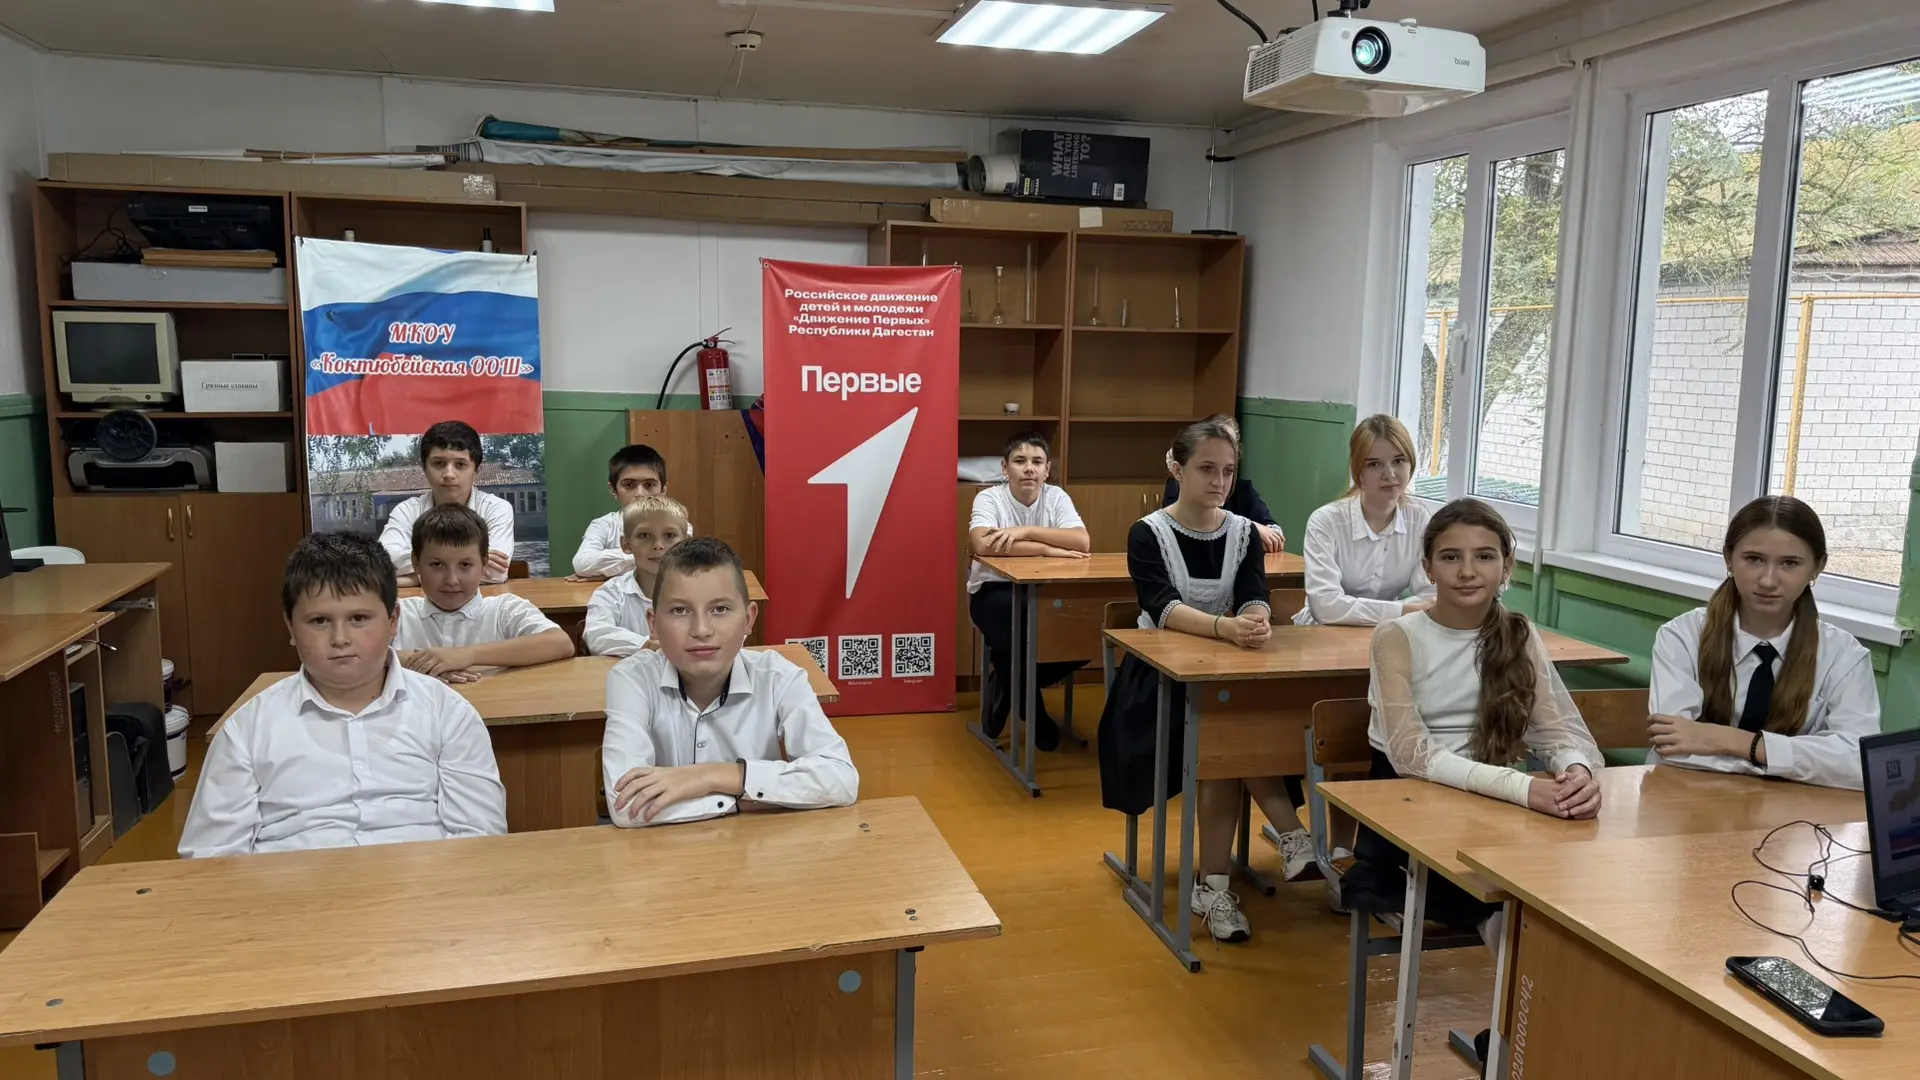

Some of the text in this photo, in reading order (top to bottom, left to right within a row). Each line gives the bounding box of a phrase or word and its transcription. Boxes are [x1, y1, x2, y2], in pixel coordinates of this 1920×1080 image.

[1051, 132, 1065, 176] WHAT
[1062, 133, 1073, 178] ARE YOU
[1070, 133, 1080, 178] LISTENING
[1080, 135, 1091, 160] TO?
[784, 288, 938, 303] Российское движение
[799, 302, 924, 314] детей и молодежи
[793, 313, 930, 326] «Движение Первых»
[389, 322, 456, 344] МКОУ
[789, 325, 935, 337] Республики Дагестан
[310, 351, 534, 377] «Коктюбейская ООШ»
[201, 382, 229, 390] Грязные
[801, 365, 922, 401] Первые
[1886, 762, 1898, 775] 30
